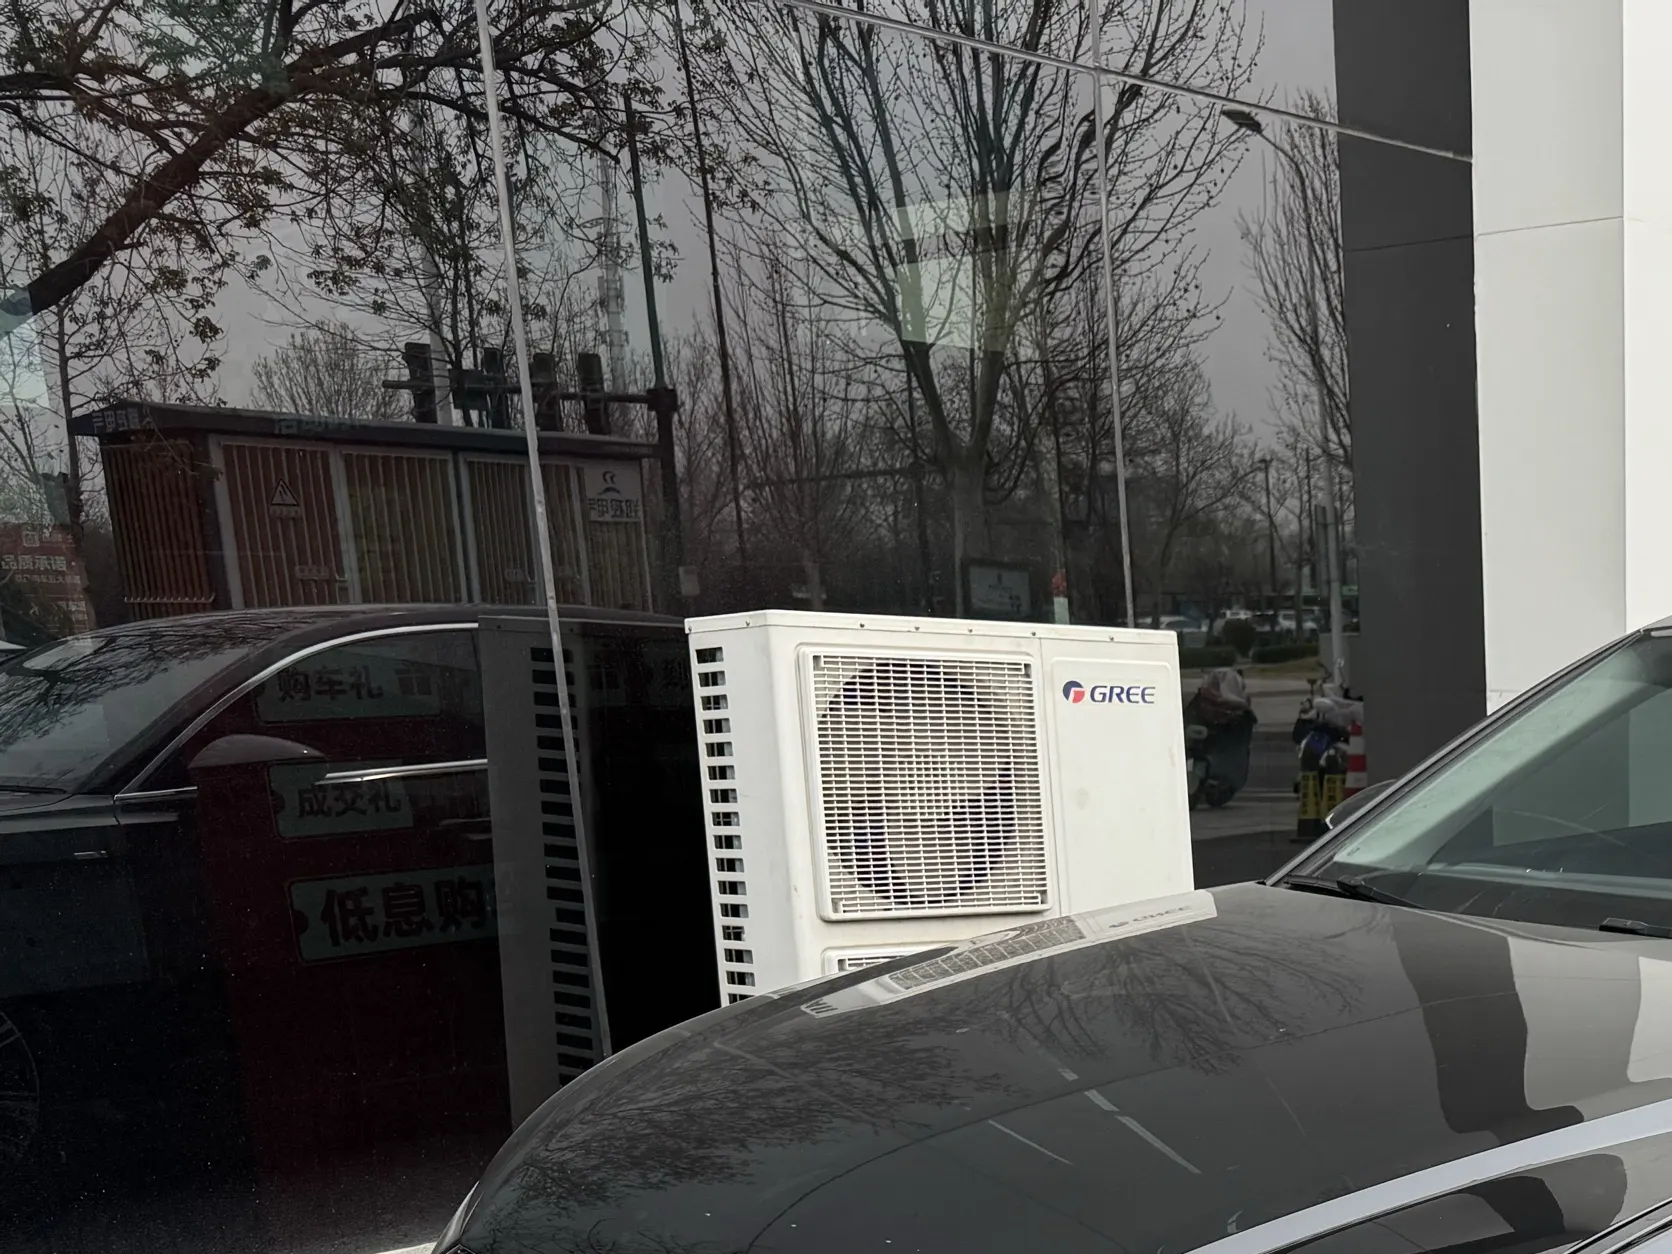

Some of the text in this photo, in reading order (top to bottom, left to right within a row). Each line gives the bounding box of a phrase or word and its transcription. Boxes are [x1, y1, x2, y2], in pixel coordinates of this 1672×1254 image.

[278, 665, 384, 702] 购车礼
[1089, 684, 1156, 705] GREE
[298, 781, 402, 819] 成交礼
[322, 876, 496, 947] 低息购
